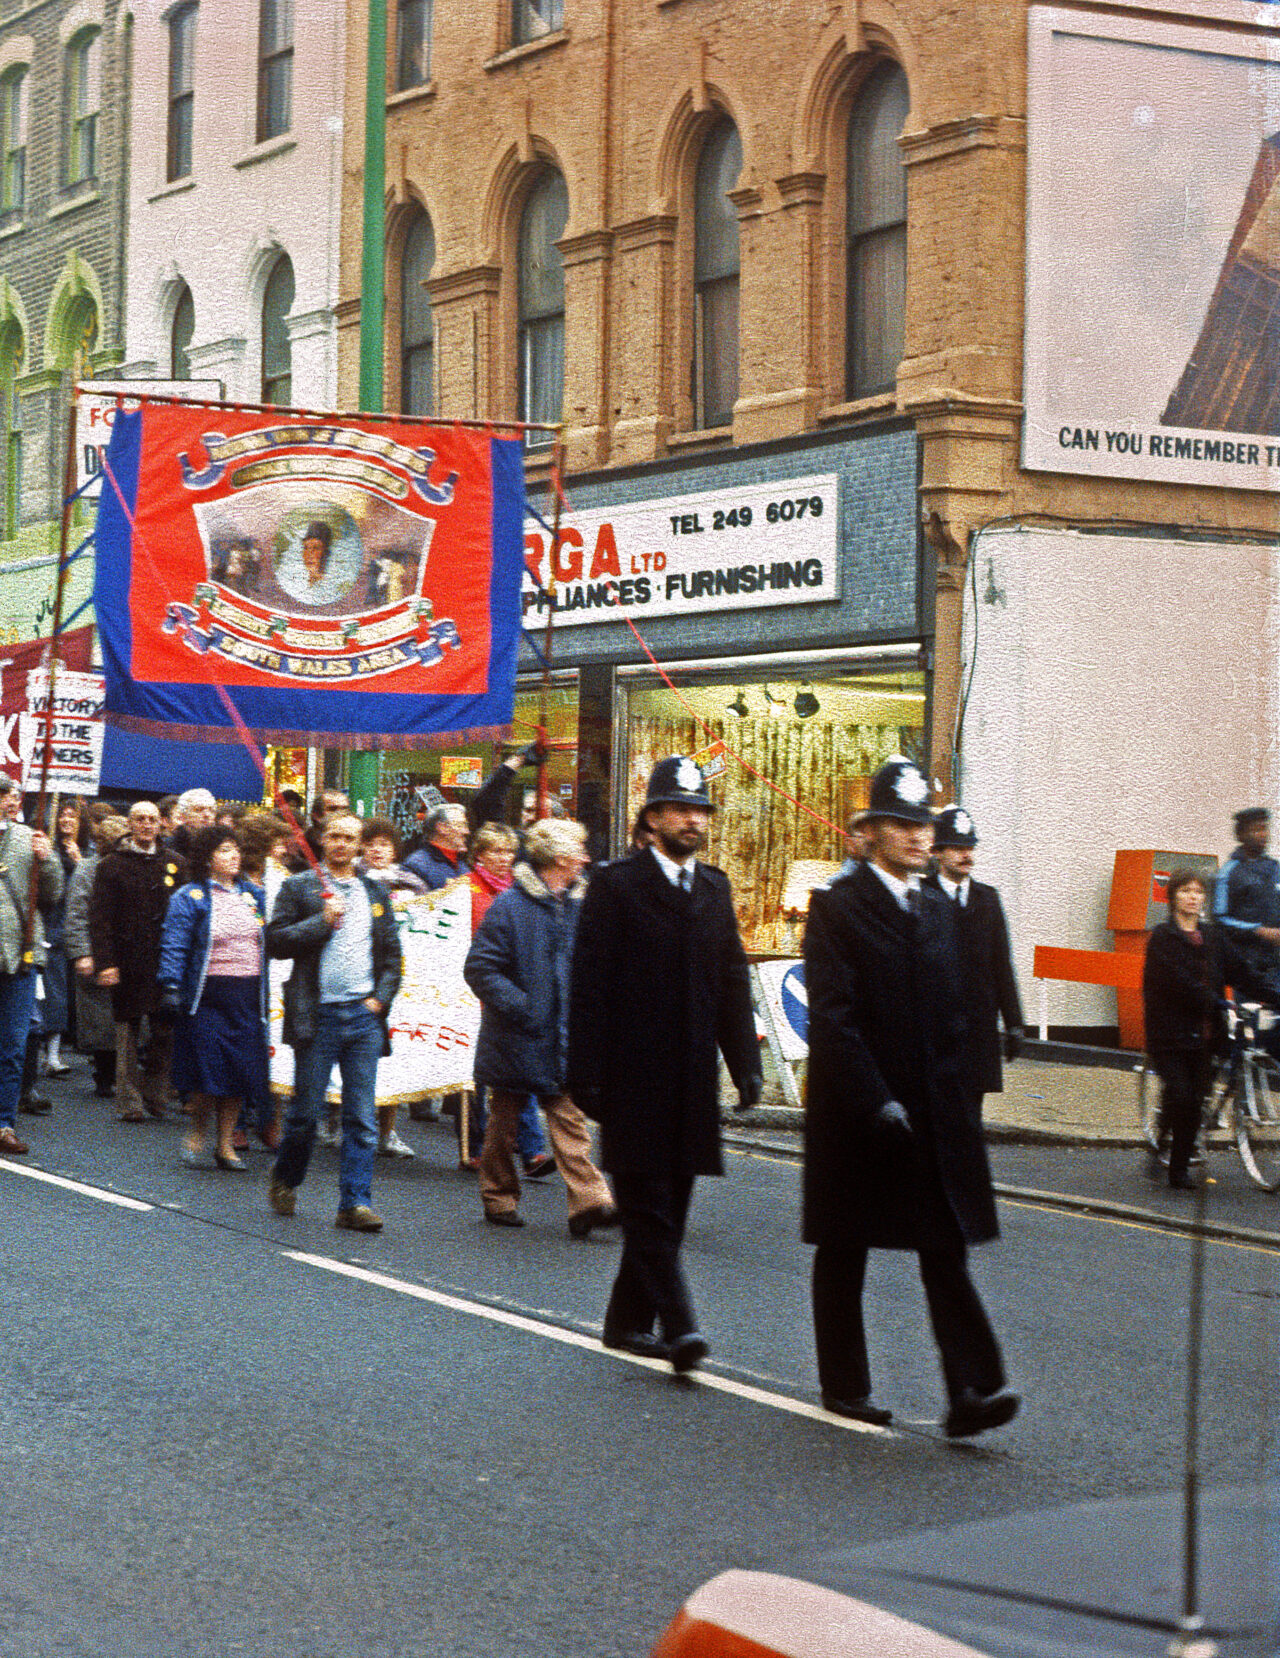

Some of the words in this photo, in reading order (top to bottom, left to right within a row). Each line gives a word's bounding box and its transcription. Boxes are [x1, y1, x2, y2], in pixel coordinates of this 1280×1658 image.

[1058, 426, 1099, 451] CAN
[1104, 431, 1142, 455] YOU
[1149, 435, 1259, 465] REMEMBER
[1265, 445, 1280, 467] T
[670, 514, 704, 535] TEL
[713, 506, 752, 531] 249
[766, 496, 823, 523] 6079
[631, 551, 666, 574] LTD
[666, 558, 823, 600] FURNISHING
[219, 636, 281, 669] SOUTH
[287, 660, 352, 677] WALES
[357, 646, 407, 672] AREA
[33, 697, 104, 713] VICTORY
[61, 723, 91, 740] THE
[33, 746, 93, 764] MNERS
